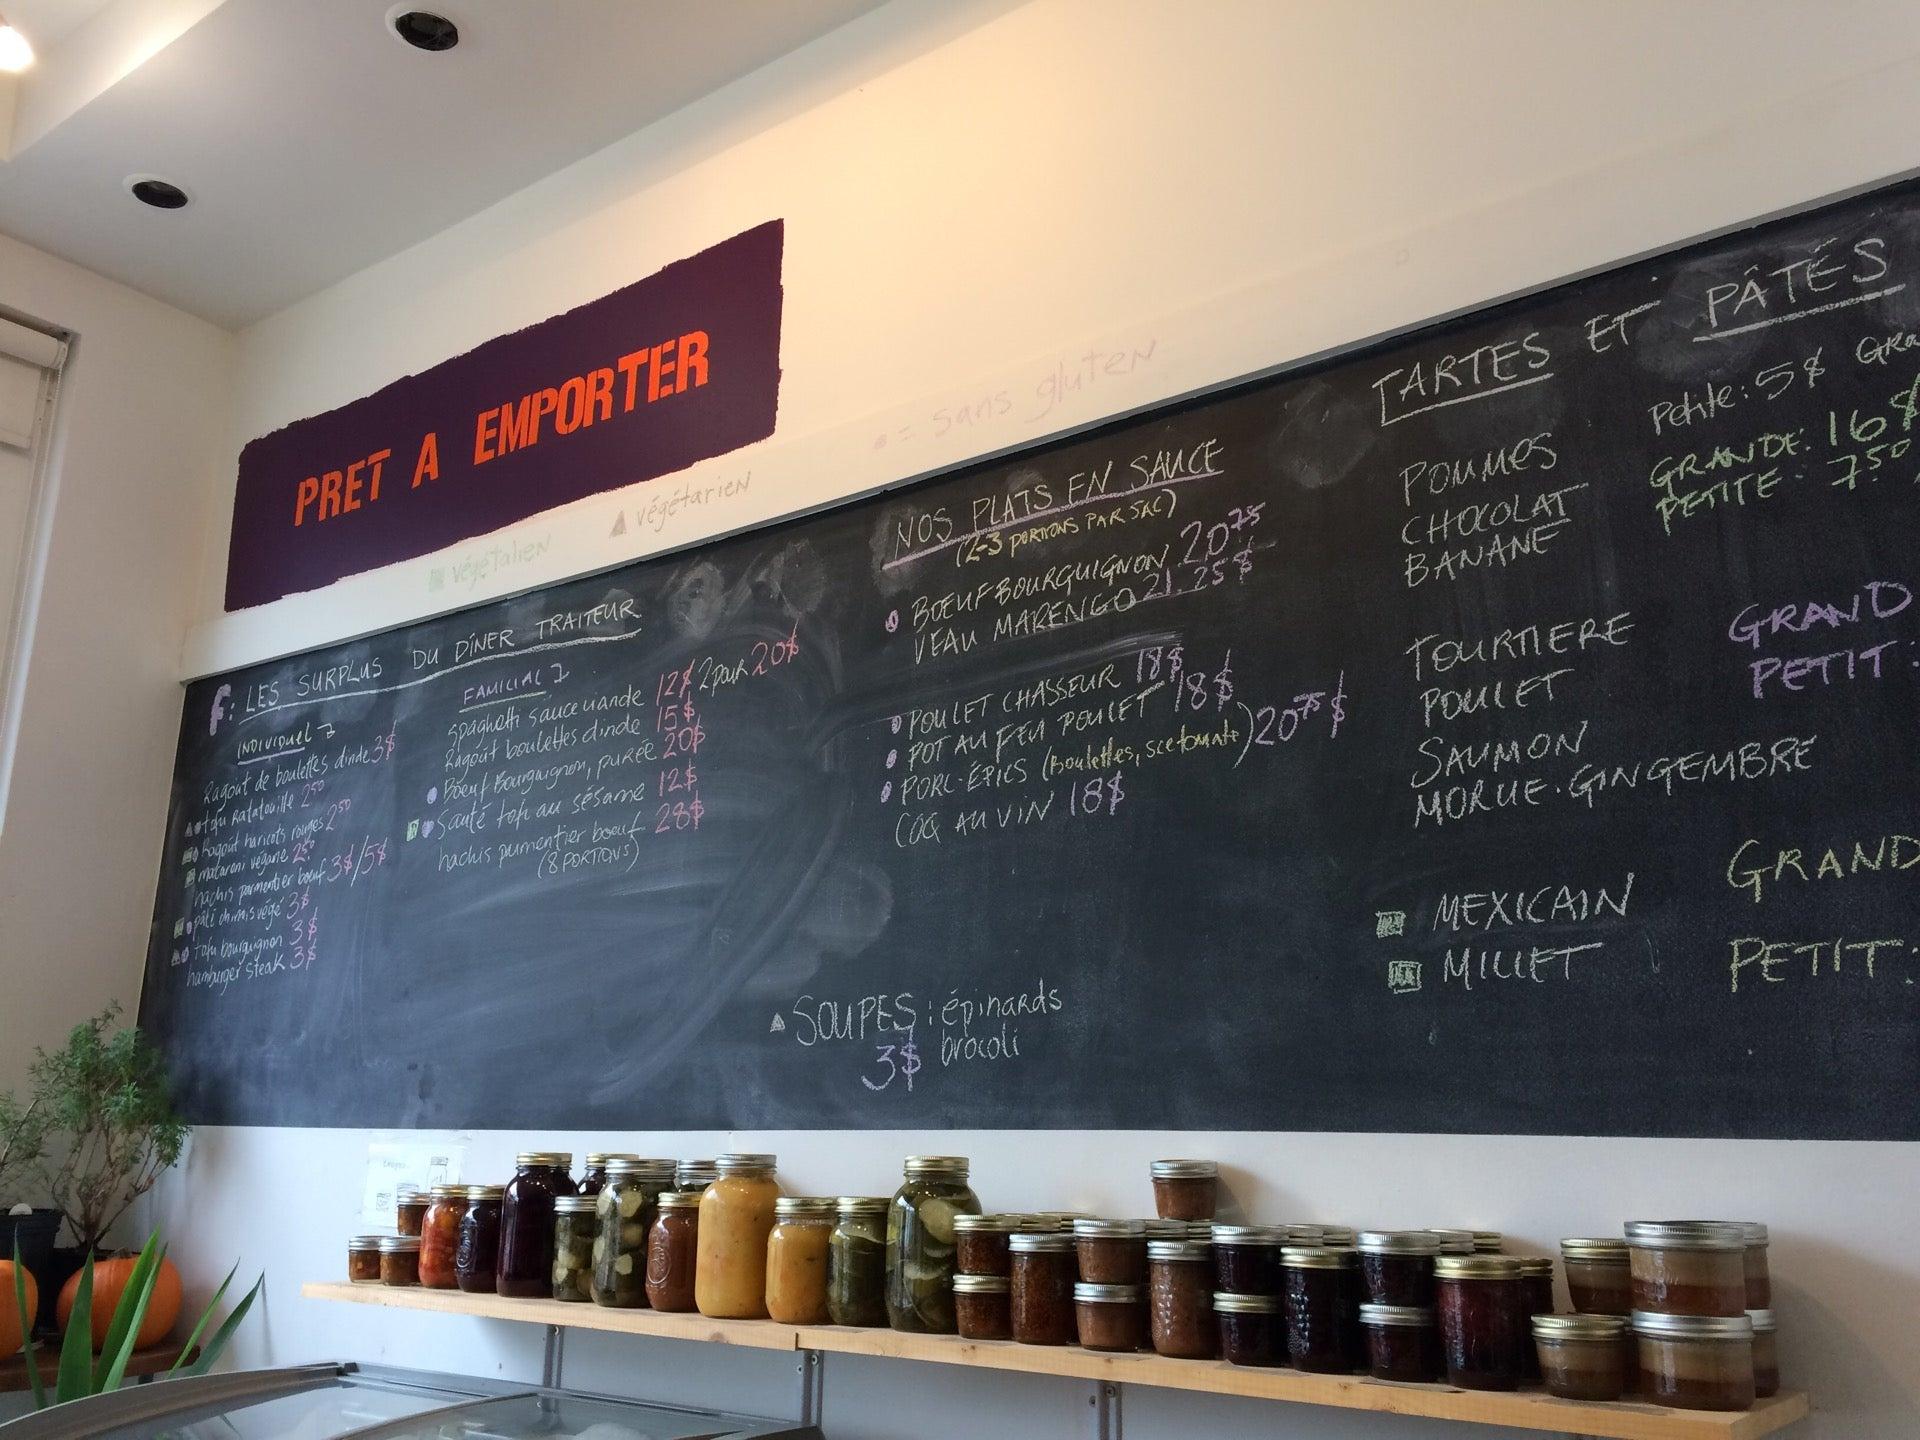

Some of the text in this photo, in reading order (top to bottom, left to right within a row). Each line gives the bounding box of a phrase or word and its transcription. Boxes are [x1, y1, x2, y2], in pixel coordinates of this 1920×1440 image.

[1372, 237, 1888, 427] TARTES ET PÂTÉS
[293, 330, 710, 527] PRET A EMPORTER
[932, 390, 1013, 438] sans
[894, 438, 1225, 560] NOS PLATS EN SAUCE
[1086, 506, 1123, 530] PAR
[1401, 482, 1589, 546] CHOCOLAT
[1405, 518, 1572, 589] BANANE
[1728, 581, 1914, 649] GRAND
[246, 681, 280, 713] LES
[413, 649, 439, 670] DU
[536, 598, 643, 640] TRAITEUR
[914, 628, 978, 665] VEAU
[528, 701, 578, 728] sauce
[909, 692, 994, 740] POULET
[1002, 664, 1121, 713] CHASSEUR
[909, 735, 951, 772] POT
[955, 730, 987, 755] AU
[996, 719, 1045, 764] FEU
[1057, 679, 1165, 737] POULET
[1420, 668, 1575, 728] POULET
[506, 725, 578, 760] boulettes
[582, 713, 641, 742] dinde
[1410, 720, 1589, 790] SAUMON
[255, 771, 270, 792] de
[536, 801, 561, 817] au
[955, 810, 987, 836] AU
[1727, 835, 1920, 903] GRAND
[1433, 871, 1635, 931] MEXICAIN
[1443, 942, 1603, 991] MILLET
